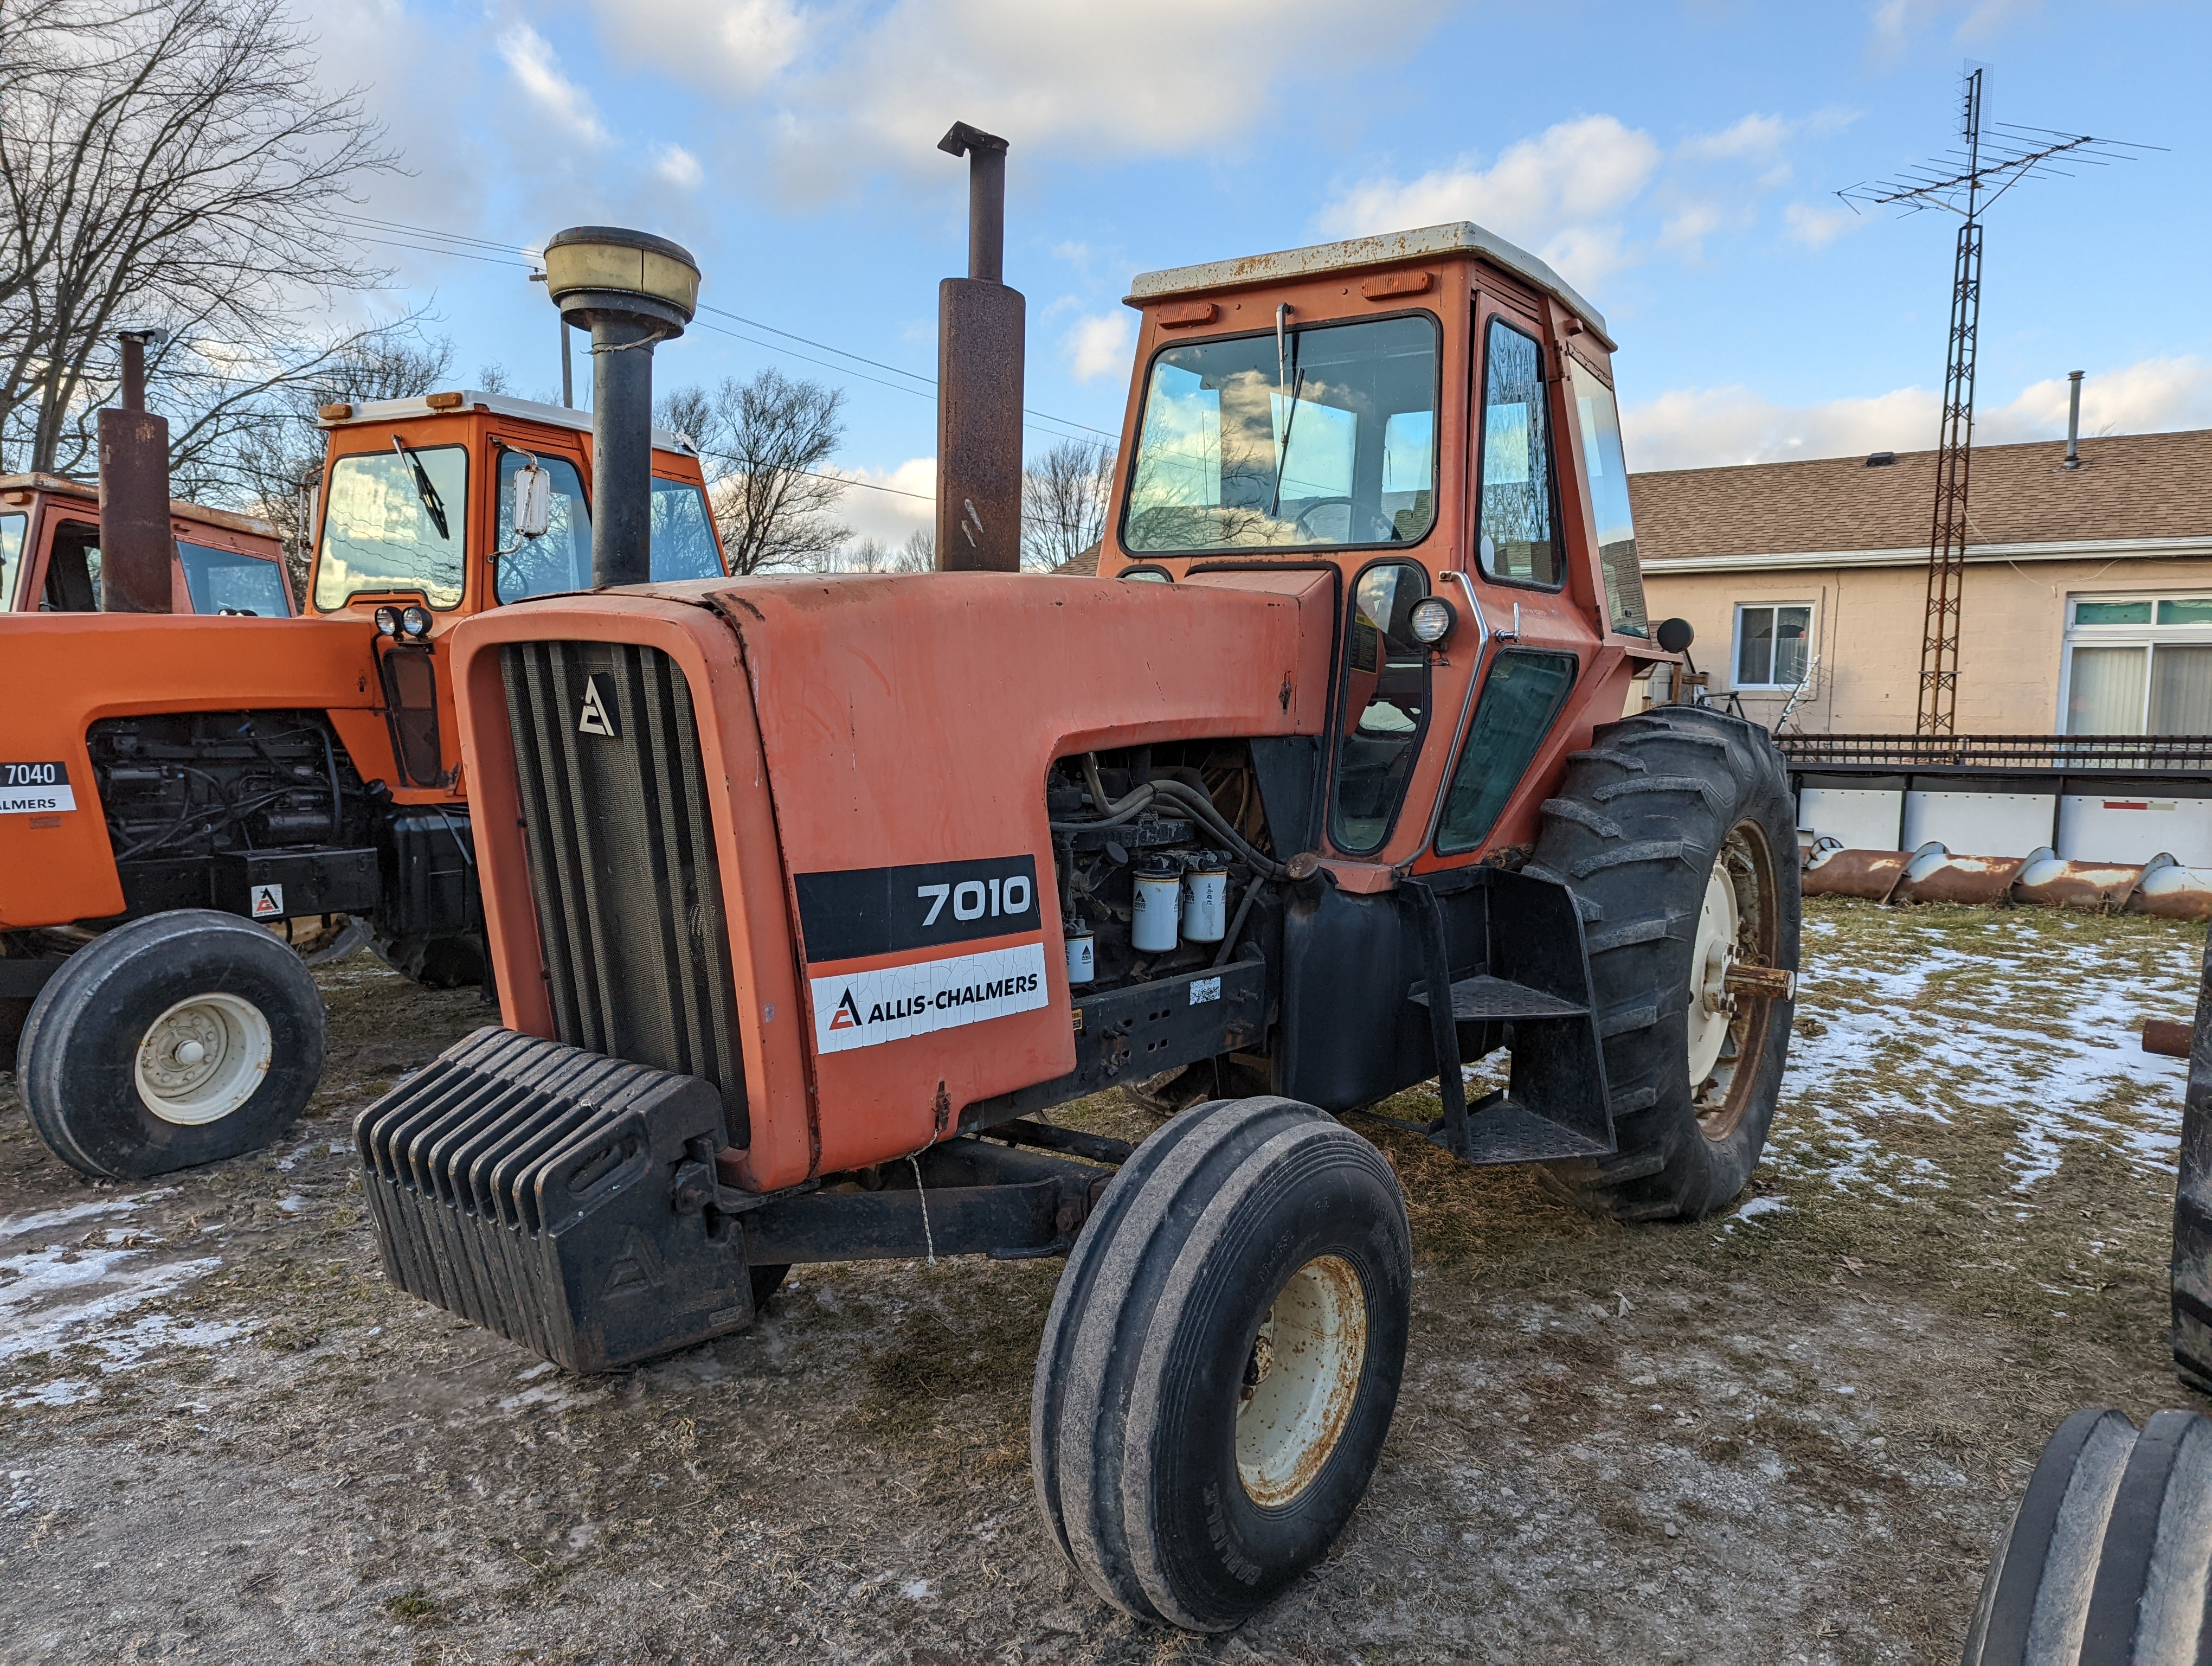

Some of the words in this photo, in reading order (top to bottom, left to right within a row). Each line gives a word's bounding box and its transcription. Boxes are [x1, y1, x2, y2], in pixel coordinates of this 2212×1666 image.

[5, 764, 55, 784] 7040
[0, 798, 56, 810] LMERS
[918, 875, 1031, 926] 7010
[867, 973, 1038, 1024] ALLIS-CHALMERS
[1202, 1482, 1263, 1586] CARLISLE
